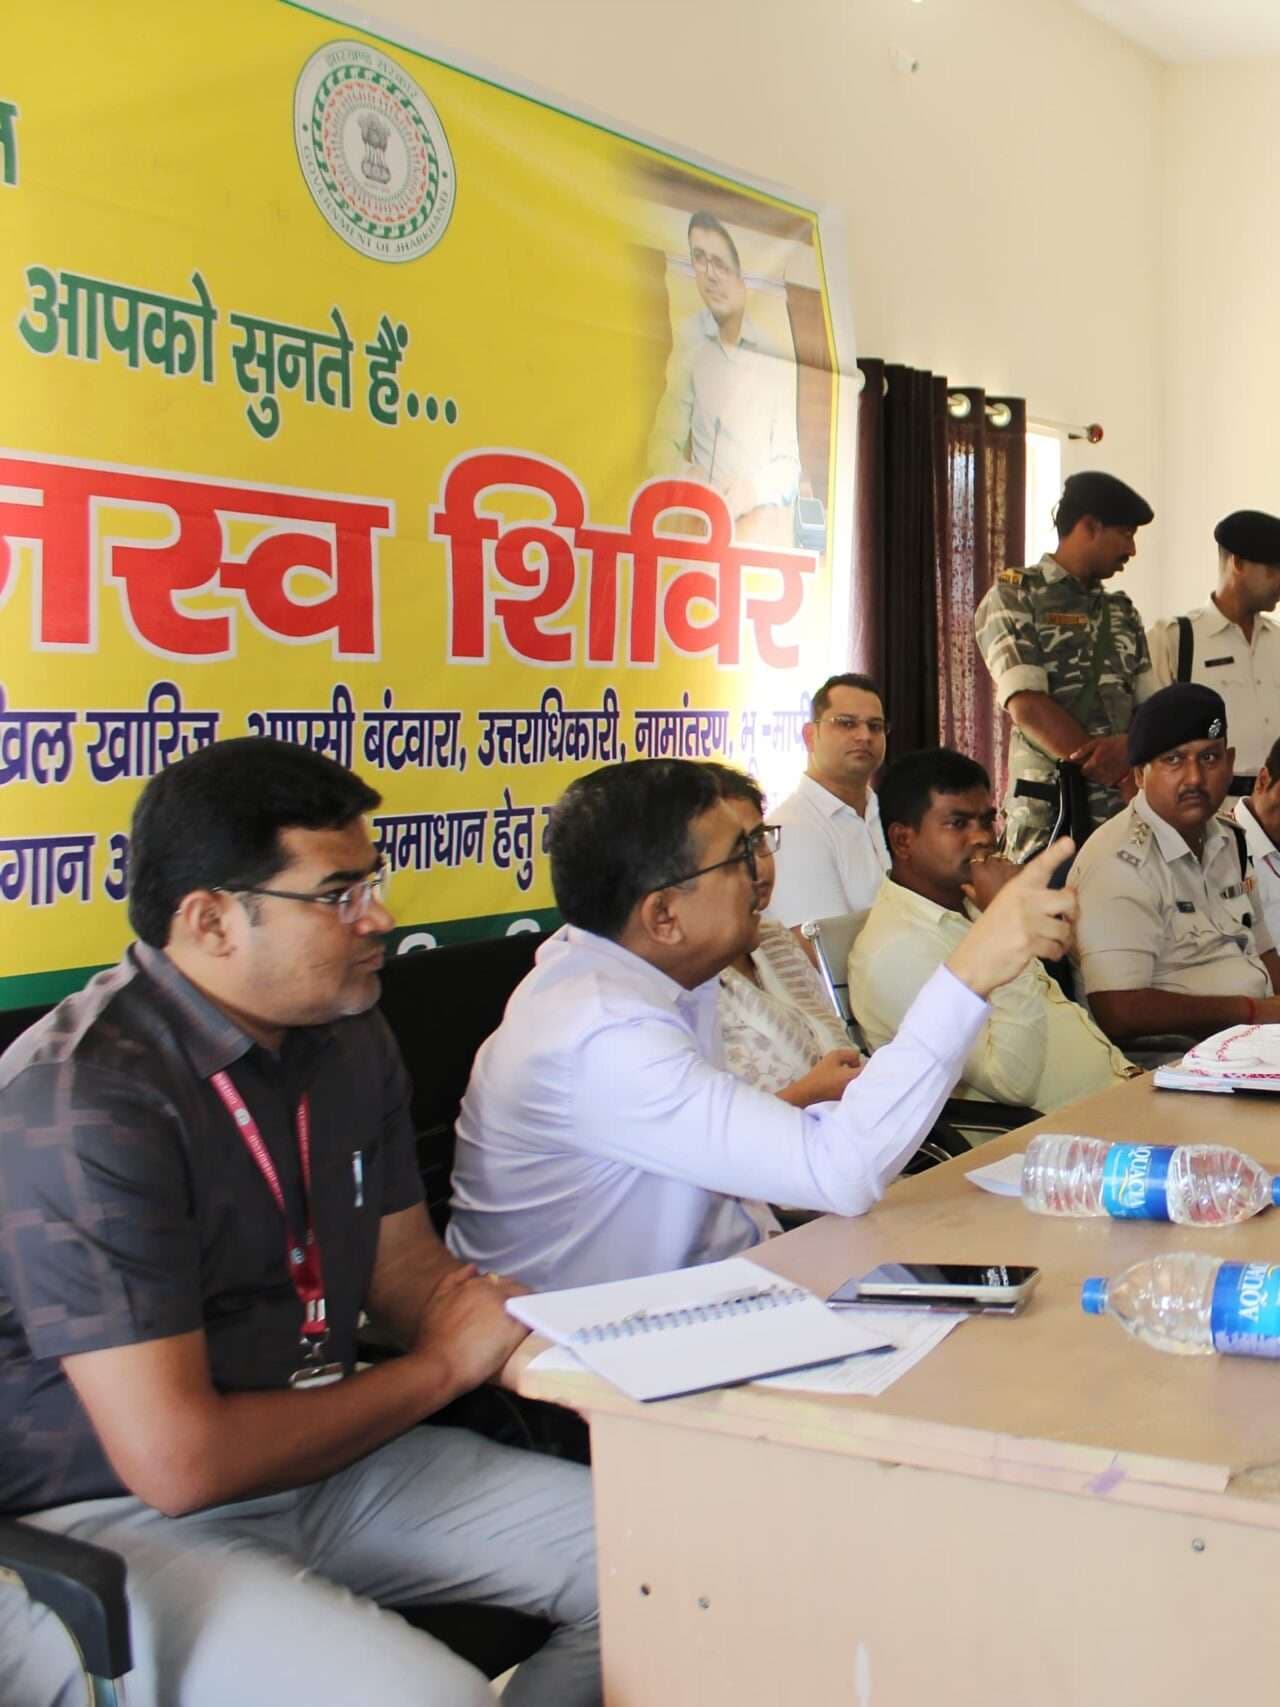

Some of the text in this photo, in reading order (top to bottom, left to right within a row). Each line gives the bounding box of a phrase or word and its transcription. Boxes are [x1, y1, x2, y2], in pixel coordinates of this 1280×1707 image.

[19, 266, 217, 382] आपको
[230, 307, 353, 438] सुनते
[434, 452, 817, 670] शिविर
[363, 688, 466, 772] बंटवारा,
[492, 787, 535, 891] हेतु
